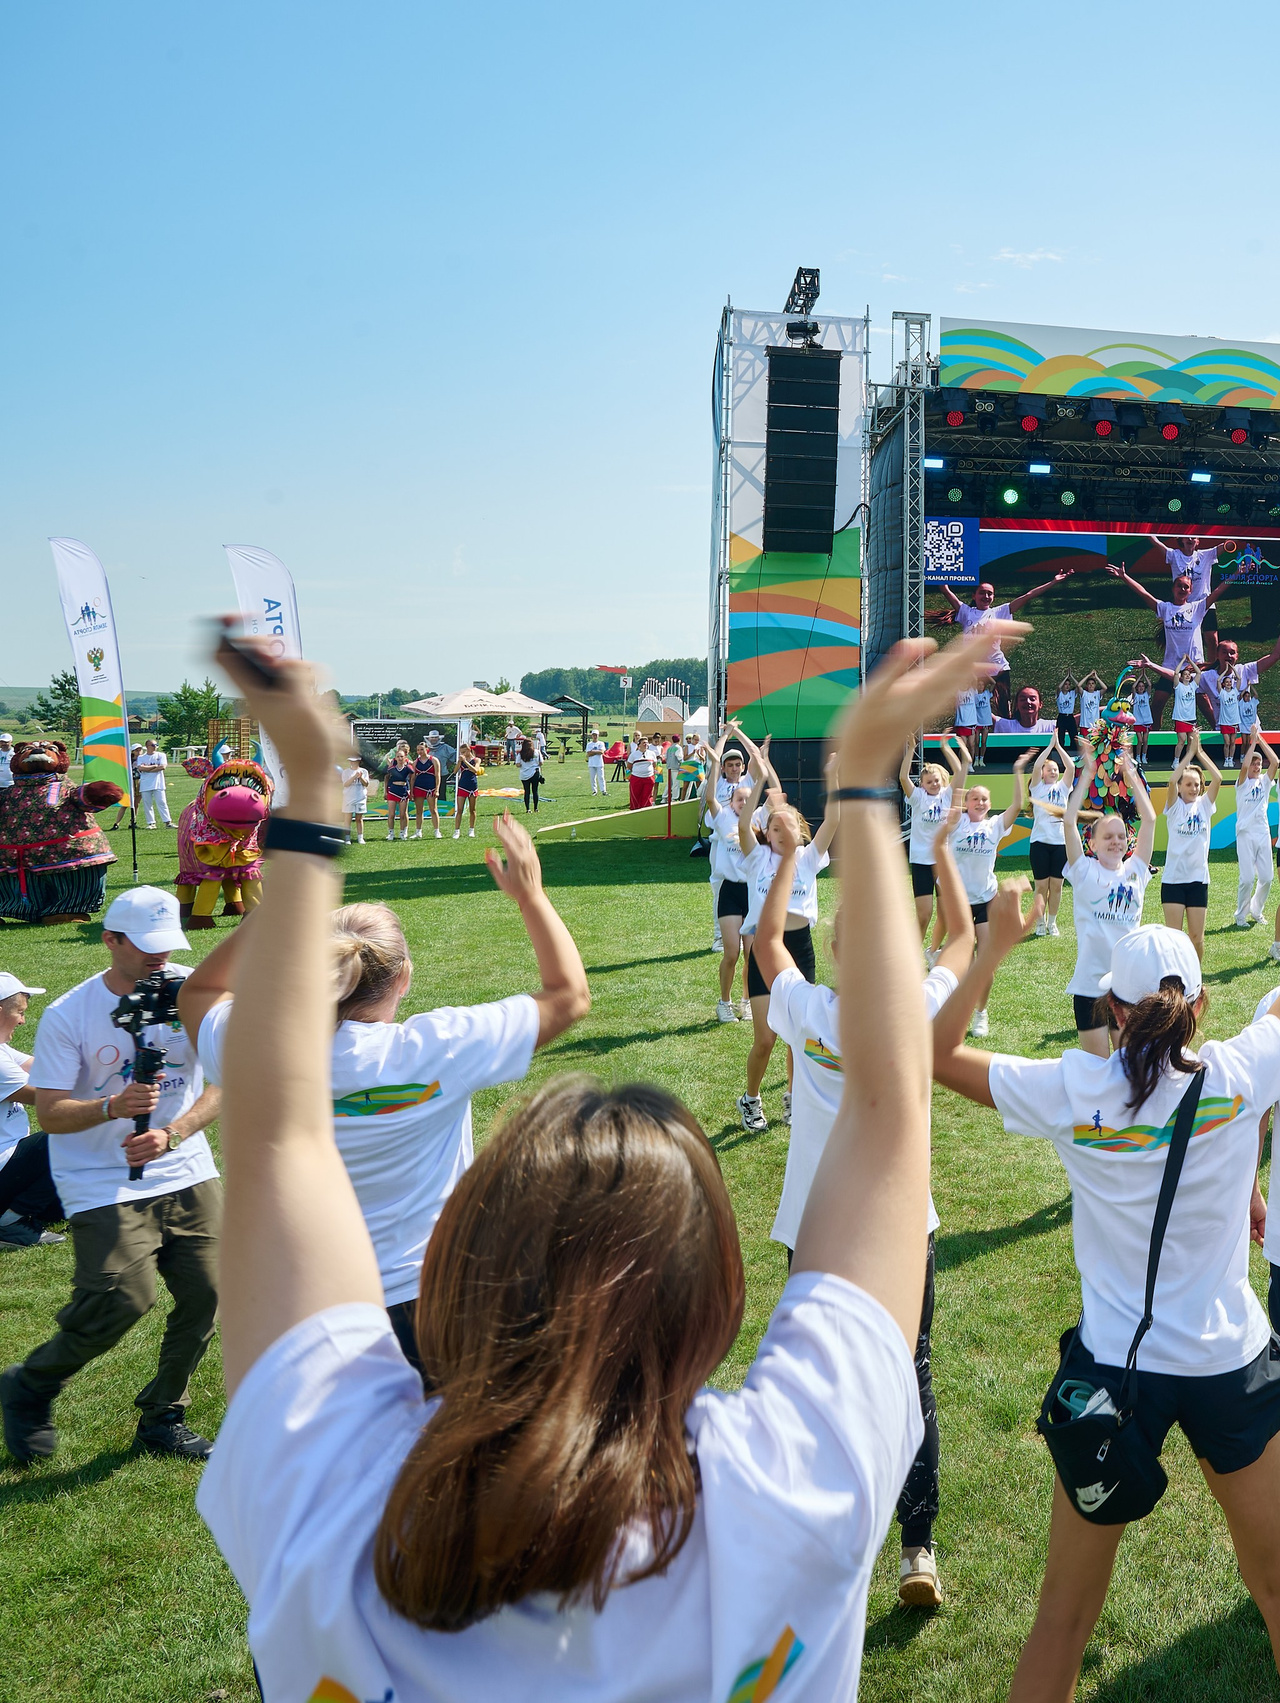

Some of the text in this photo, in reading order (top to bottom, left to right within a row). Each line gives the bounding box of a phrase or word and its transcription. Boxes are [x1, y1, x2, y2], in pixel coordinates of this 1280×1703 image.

[622, 677, 628, 687] 5
[159, 1077, 185, 1092] ОРТА
[1075, 1480, 1105, 1502] NIKE
